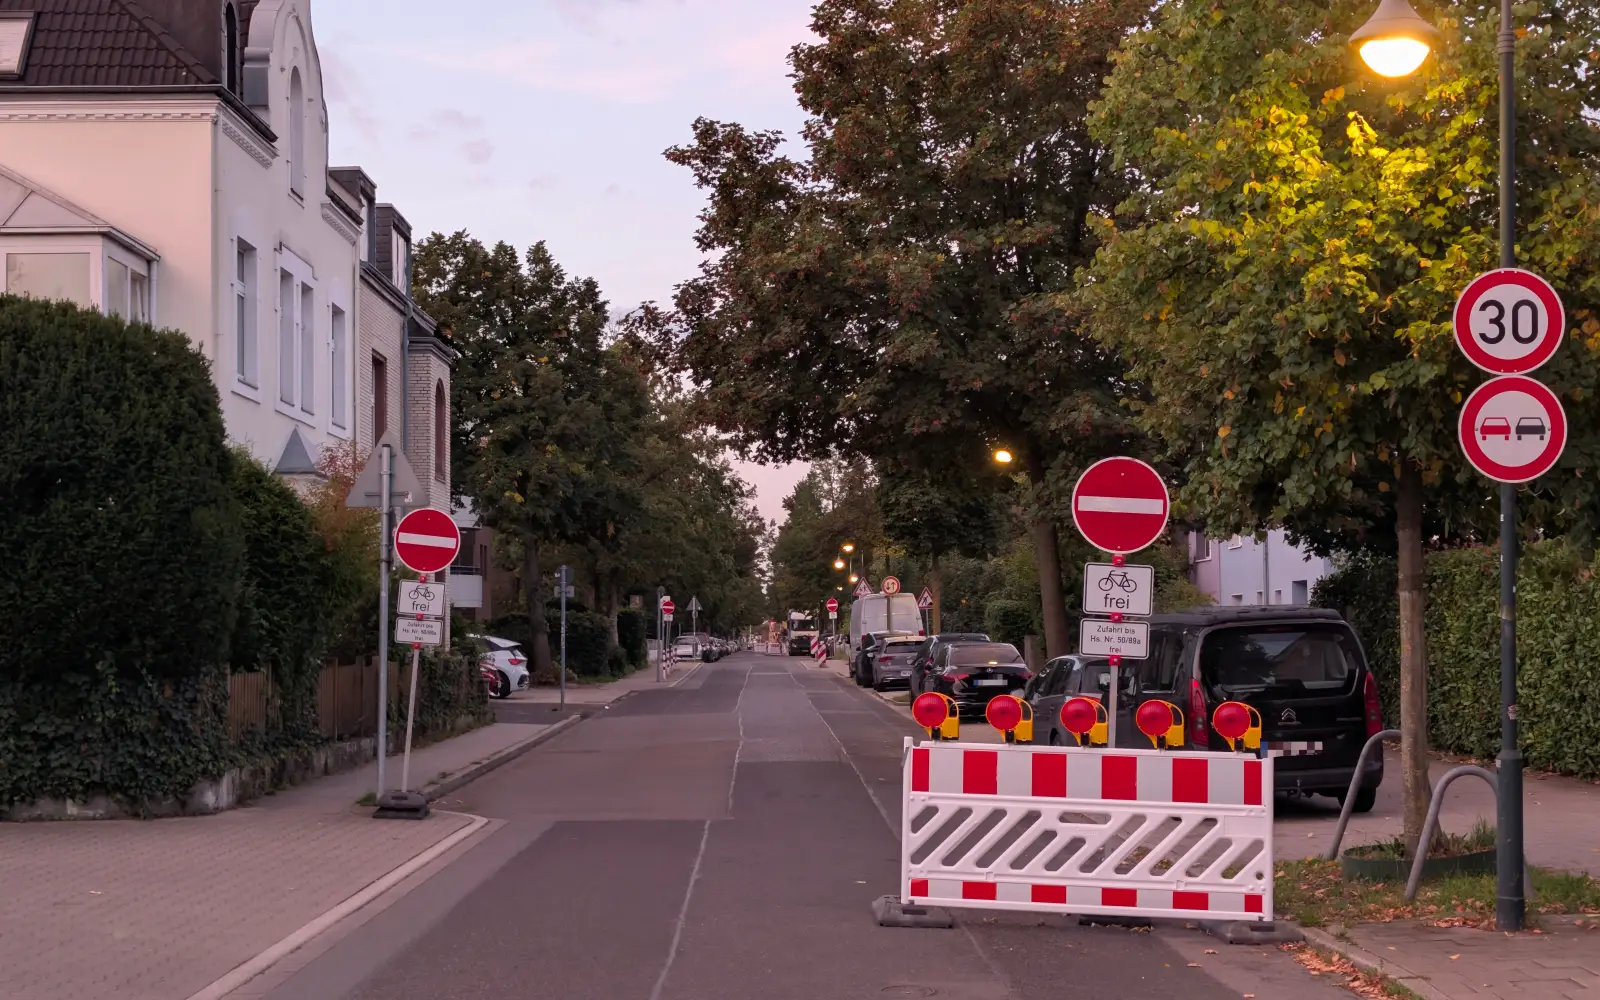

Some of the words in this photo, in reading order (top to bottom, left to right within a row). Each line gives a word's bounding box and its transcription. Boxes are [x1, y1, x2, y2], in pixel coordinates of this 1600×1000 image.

[1478, 299, 1539, 345] 30
[412, 600, 430, 612] frei
[1103, 593, 1130, 609] frei
[1096, 625, 1123, 633] Zufahrt
[1125, 626, 1136, 634] bis
[1117, 636, 1141, 644] 50/89a
